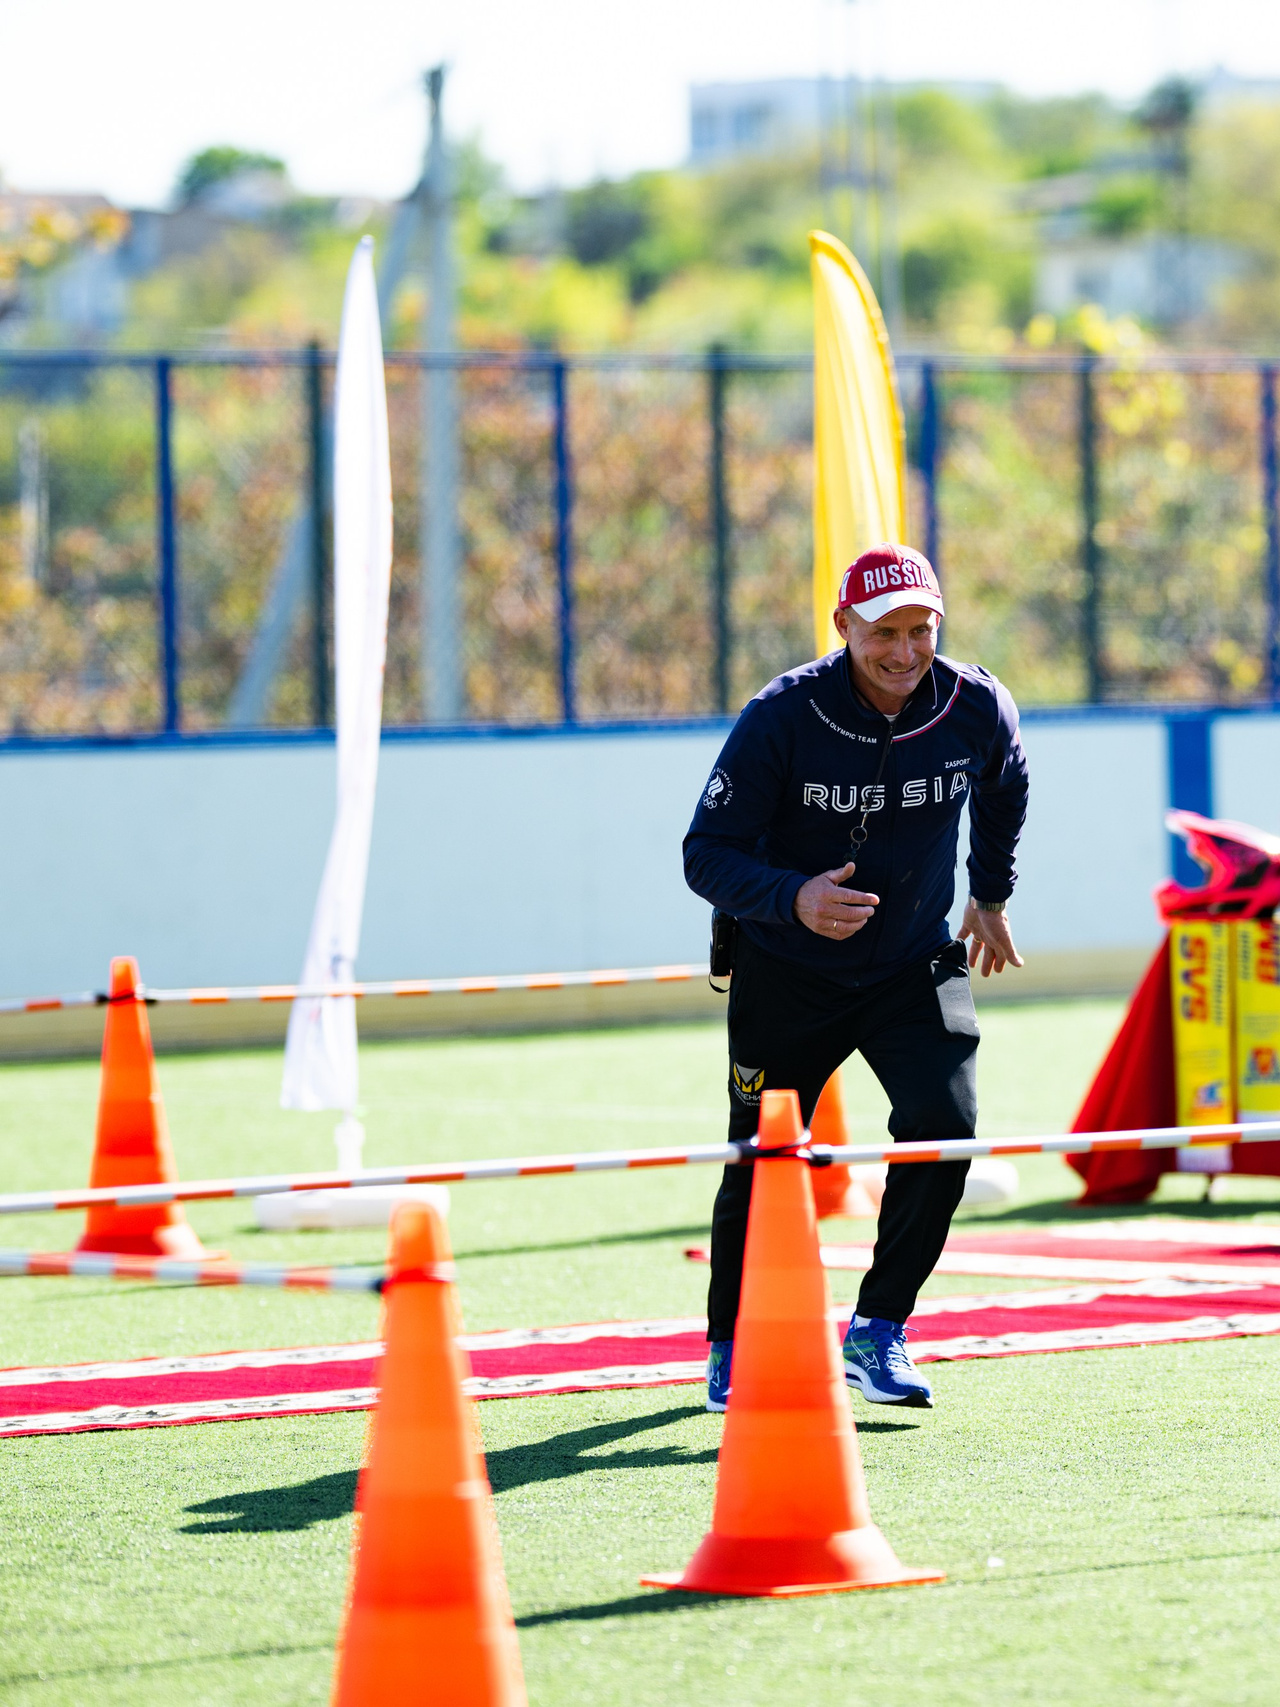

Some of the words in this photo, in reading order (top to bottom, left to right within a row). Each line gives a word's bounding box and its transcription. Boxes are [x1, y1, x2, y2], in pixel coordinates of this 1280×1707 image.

[863, 560, 932, 594] RUSSIA
[809, 698, 830, 724] RUSSIAN
[830, 722, 856, 740] OLYMPIC
[858, 735, 877, 744] TEAM
[944, 758, 971, 768] ZASPORT
